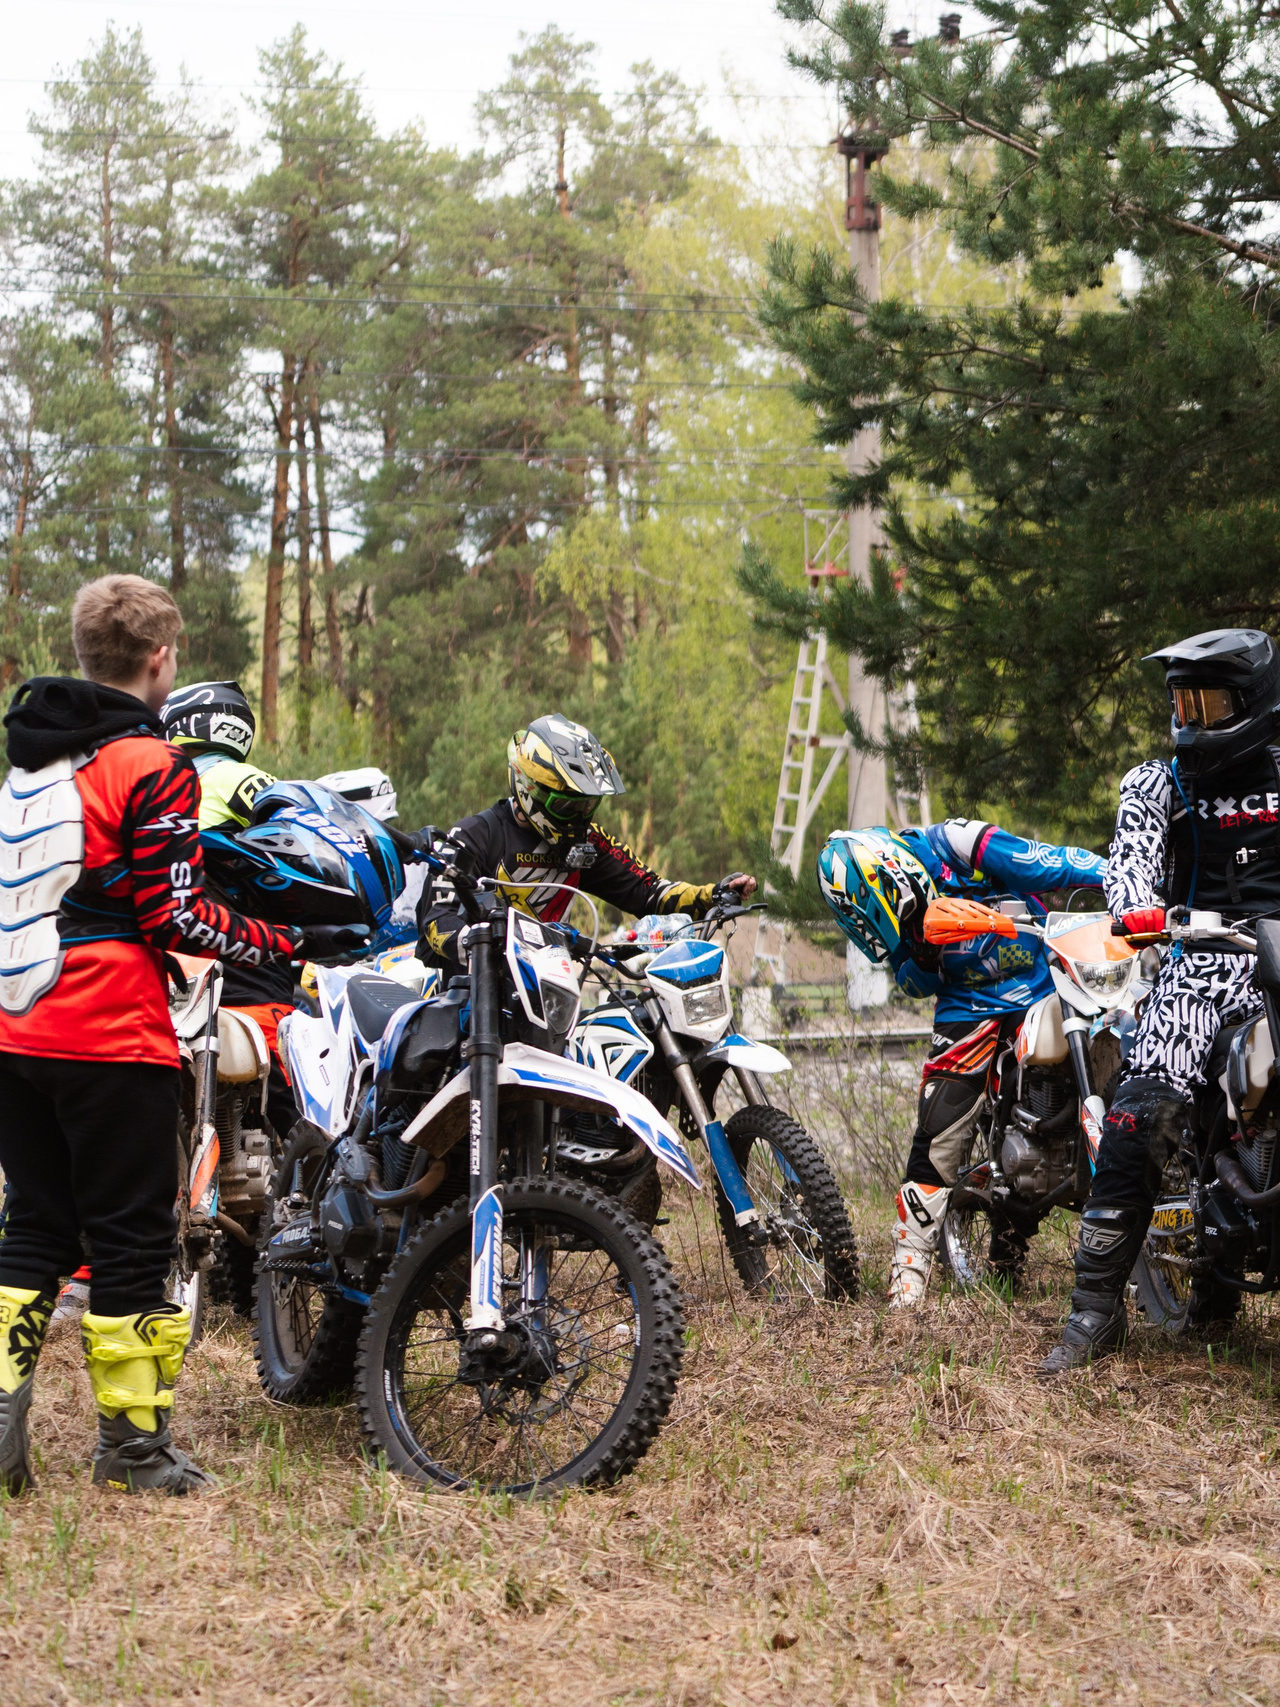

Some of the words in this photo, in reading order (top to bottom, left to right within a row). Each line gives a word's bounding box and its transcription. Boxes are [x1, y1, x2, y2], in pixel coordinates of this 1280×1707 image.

[212, 721, 252, 747] FOX
[875, 850, 909, 888] ATAKI
[170, 860, 287, 967] SHARMAX
[492, 1211, 504, 1304] PROGASI
